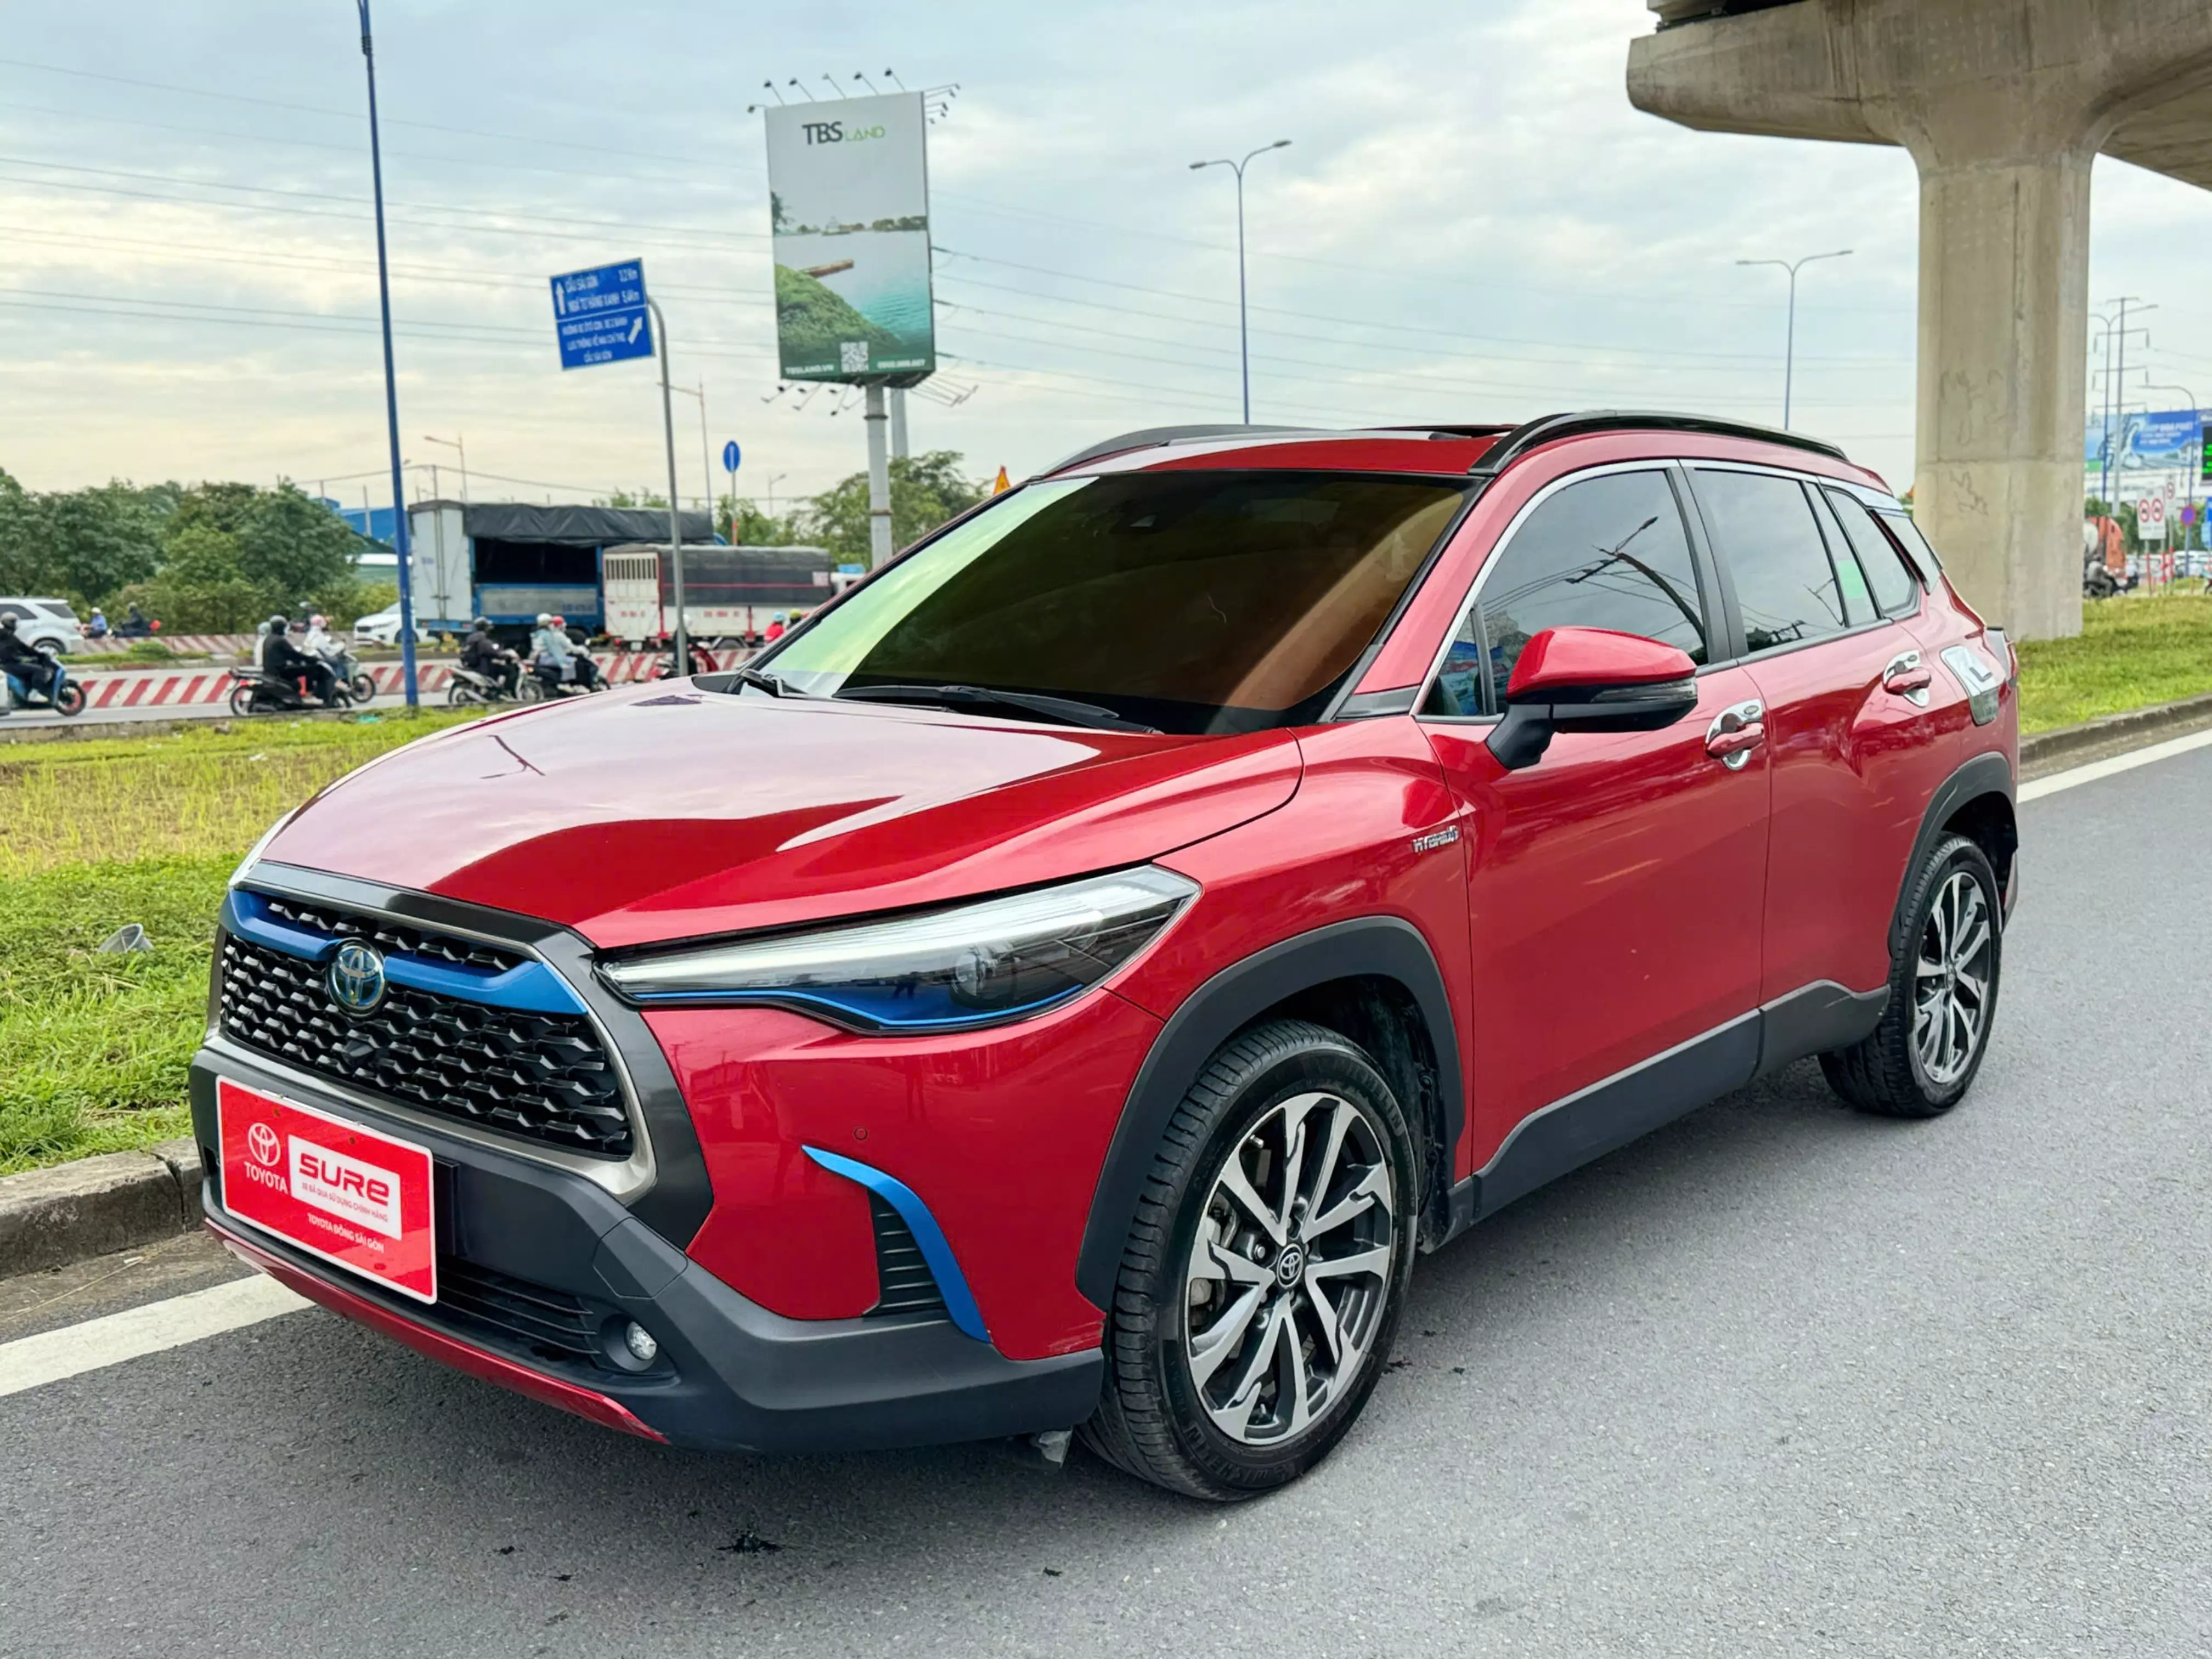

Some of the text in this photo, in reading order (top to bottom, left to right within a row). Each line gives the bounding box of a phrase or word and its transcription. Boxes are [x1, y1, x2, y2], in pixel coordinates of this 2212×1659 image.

[802, 121, 843, 145] TBS
[245, 1161, 288, 1194] TOYOTA
[307, 1212, 384, 1254] TOYOTA ĐÔNG SÀI GÒN
